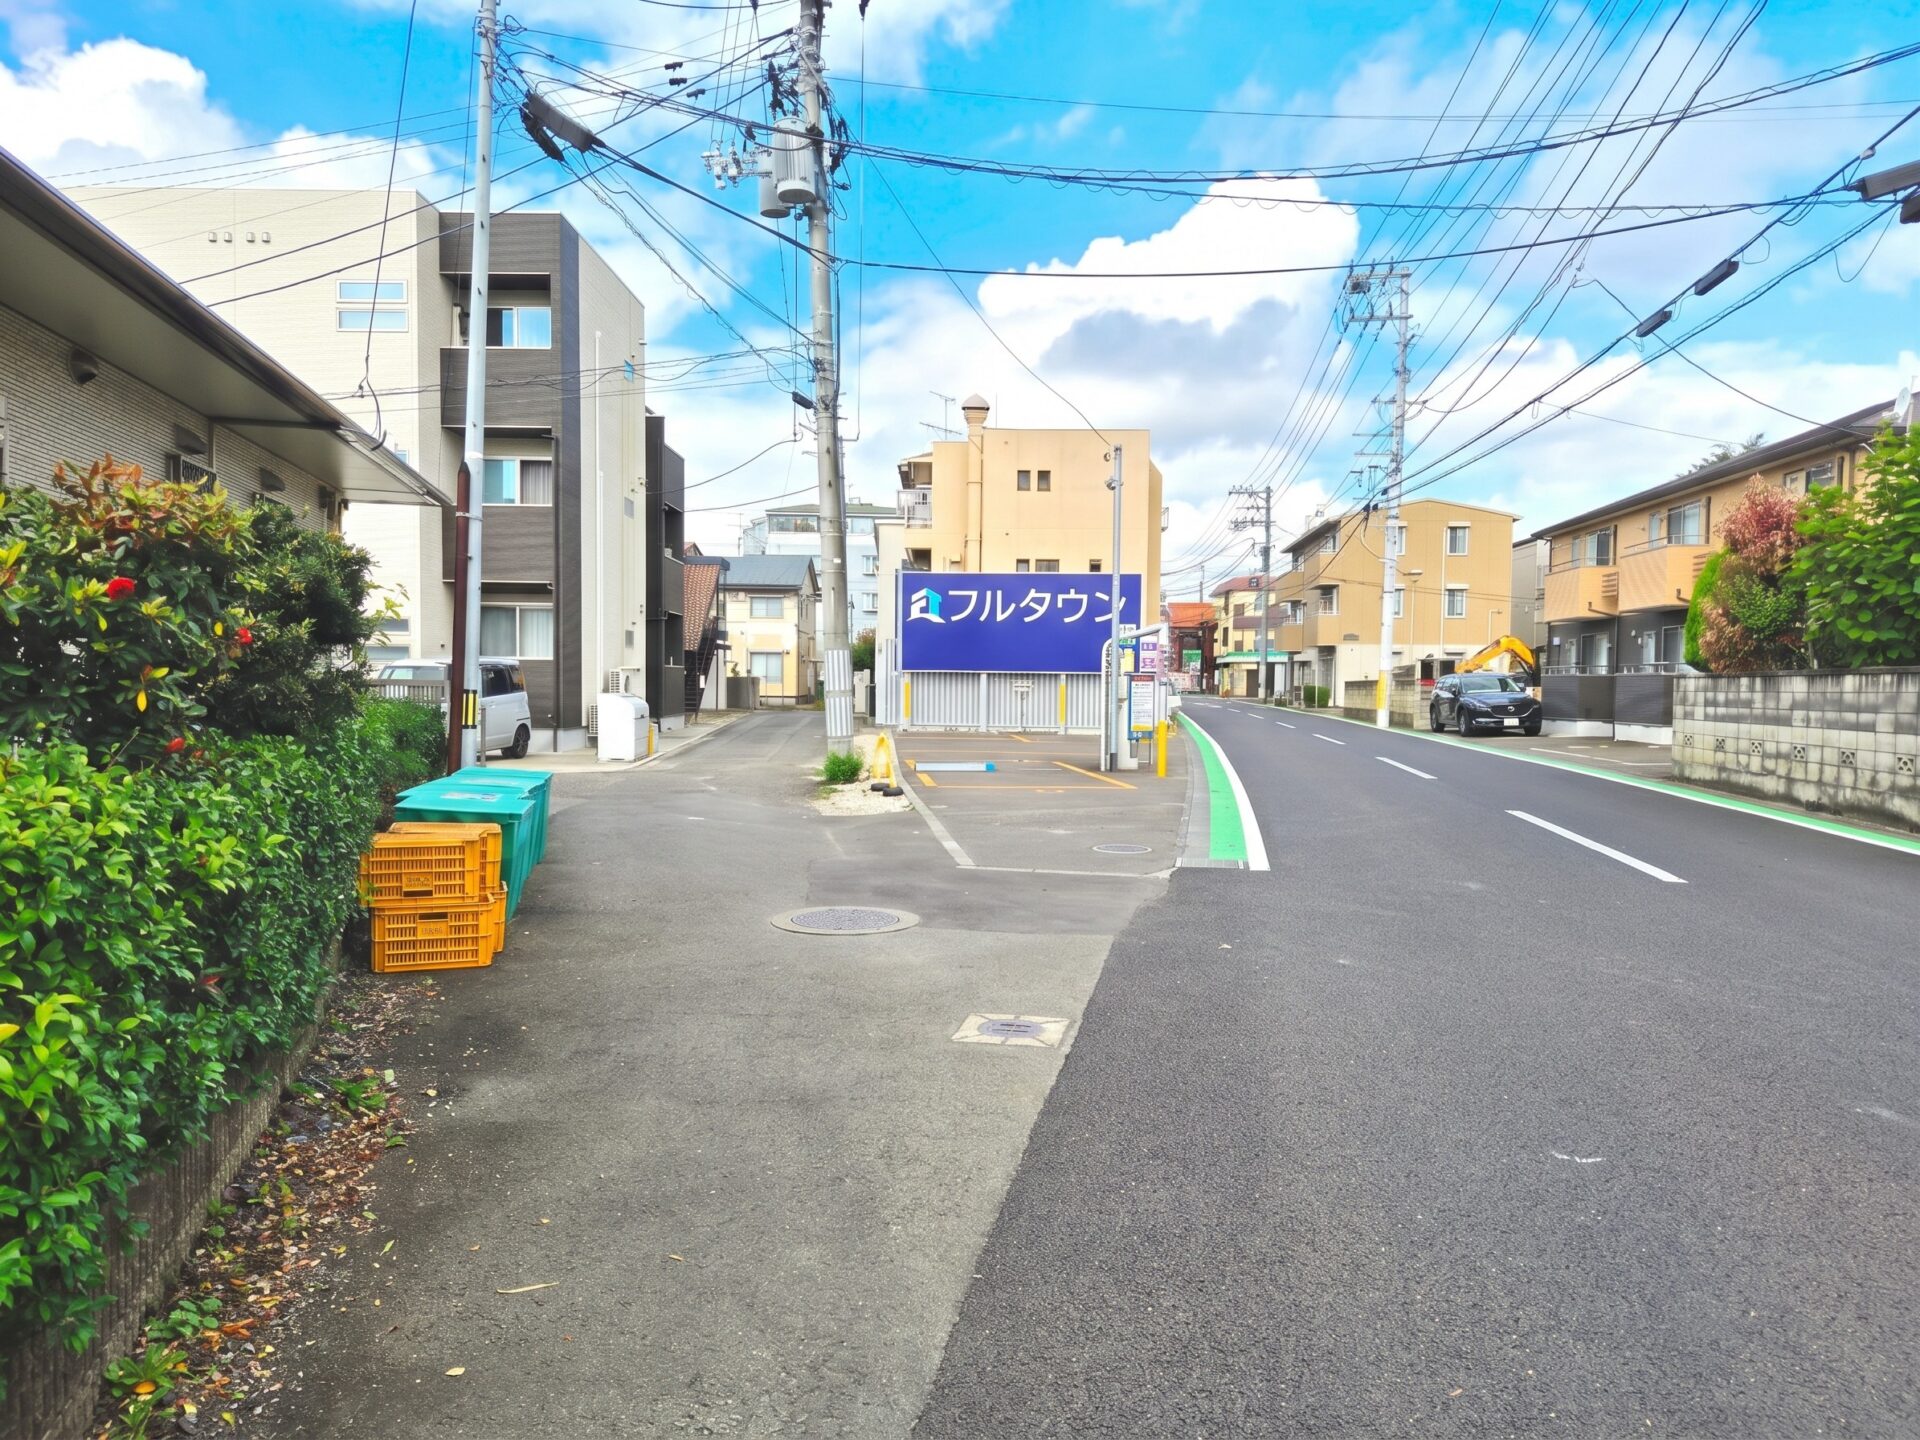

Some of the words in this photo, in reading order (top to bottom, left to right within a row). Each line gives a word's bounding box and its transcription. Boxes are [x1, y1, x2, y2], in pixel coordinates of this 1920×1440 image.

[948, 588, 1127, 623] フルタウン
